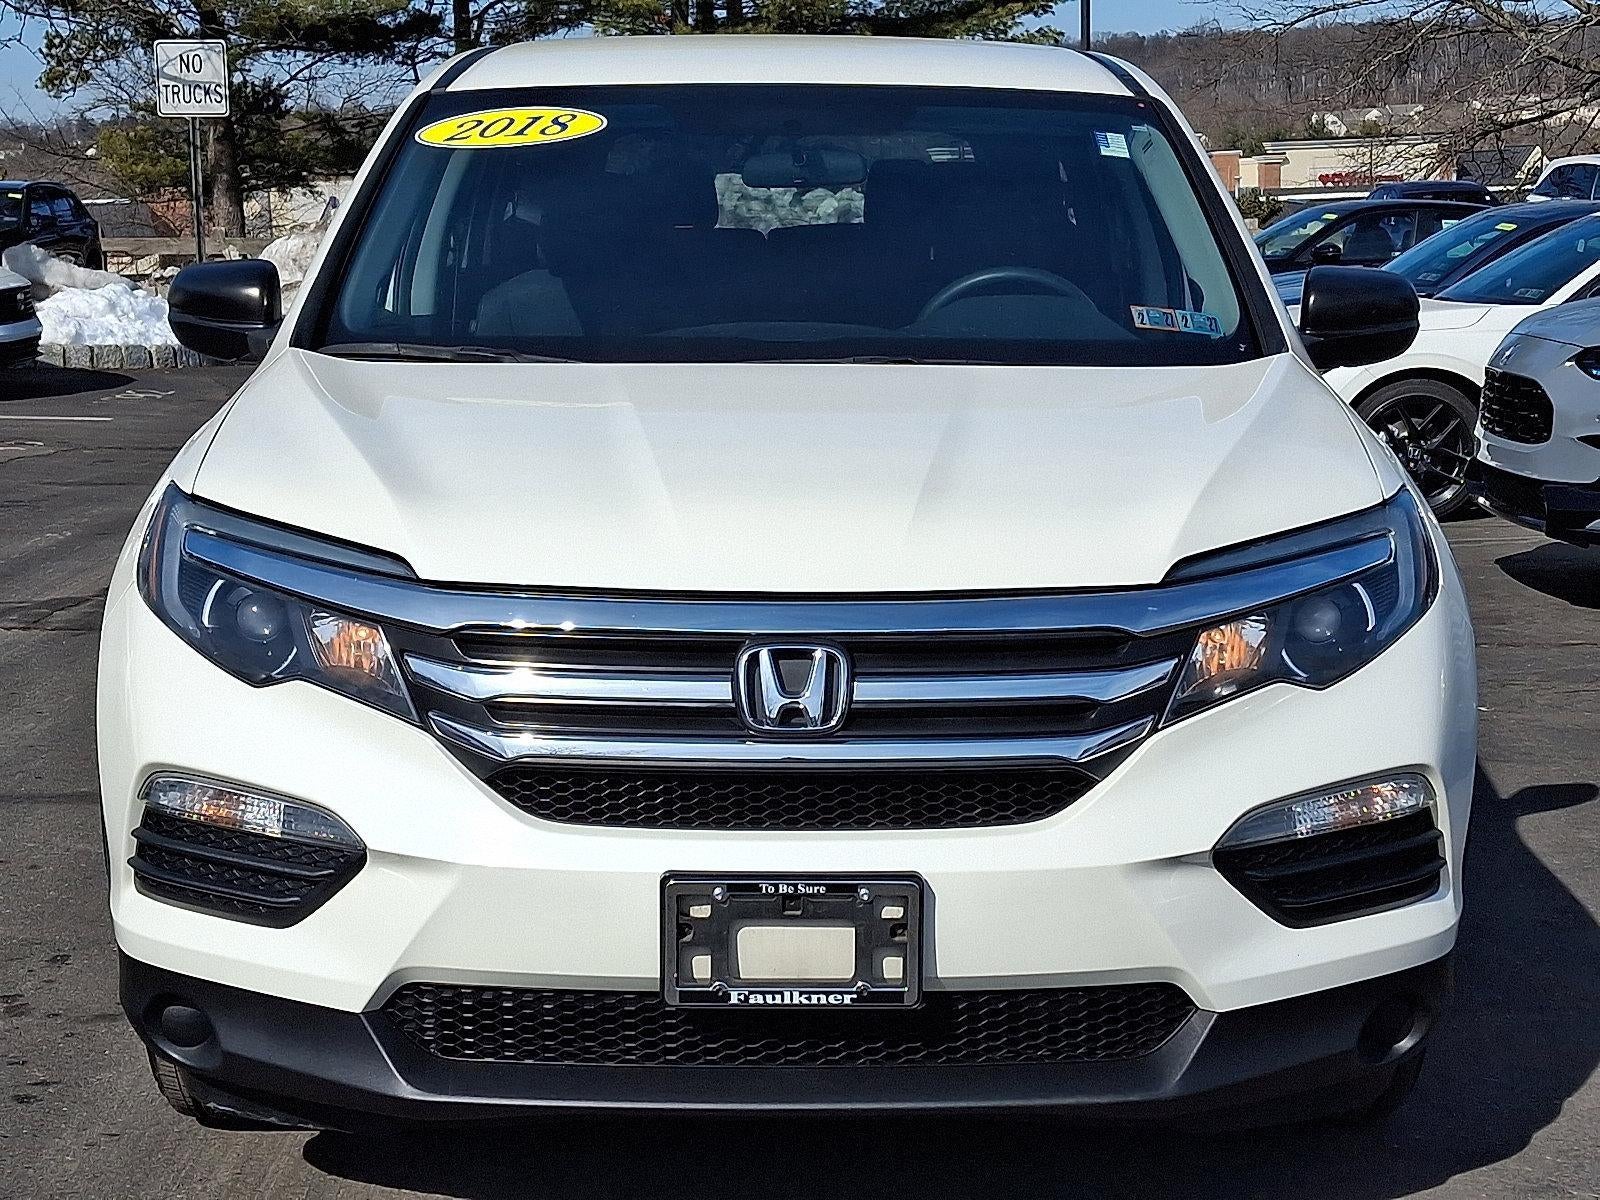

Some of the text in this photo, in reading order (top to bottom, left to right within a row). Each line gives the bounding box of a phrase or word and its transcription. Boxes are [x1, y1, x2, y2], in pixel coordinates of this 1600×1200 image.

[179, 53, 203, 74] NO
[161, 83, 224, 104] TRUCKS
[443, 113, 577, 142] 2018
[1137, 312, 1146, 325] 2
[1181, 313, 1191, 329] 2
[759, 883, 827, 894] To Be Sure
[728, 990, 857, 1004] Faulkner
